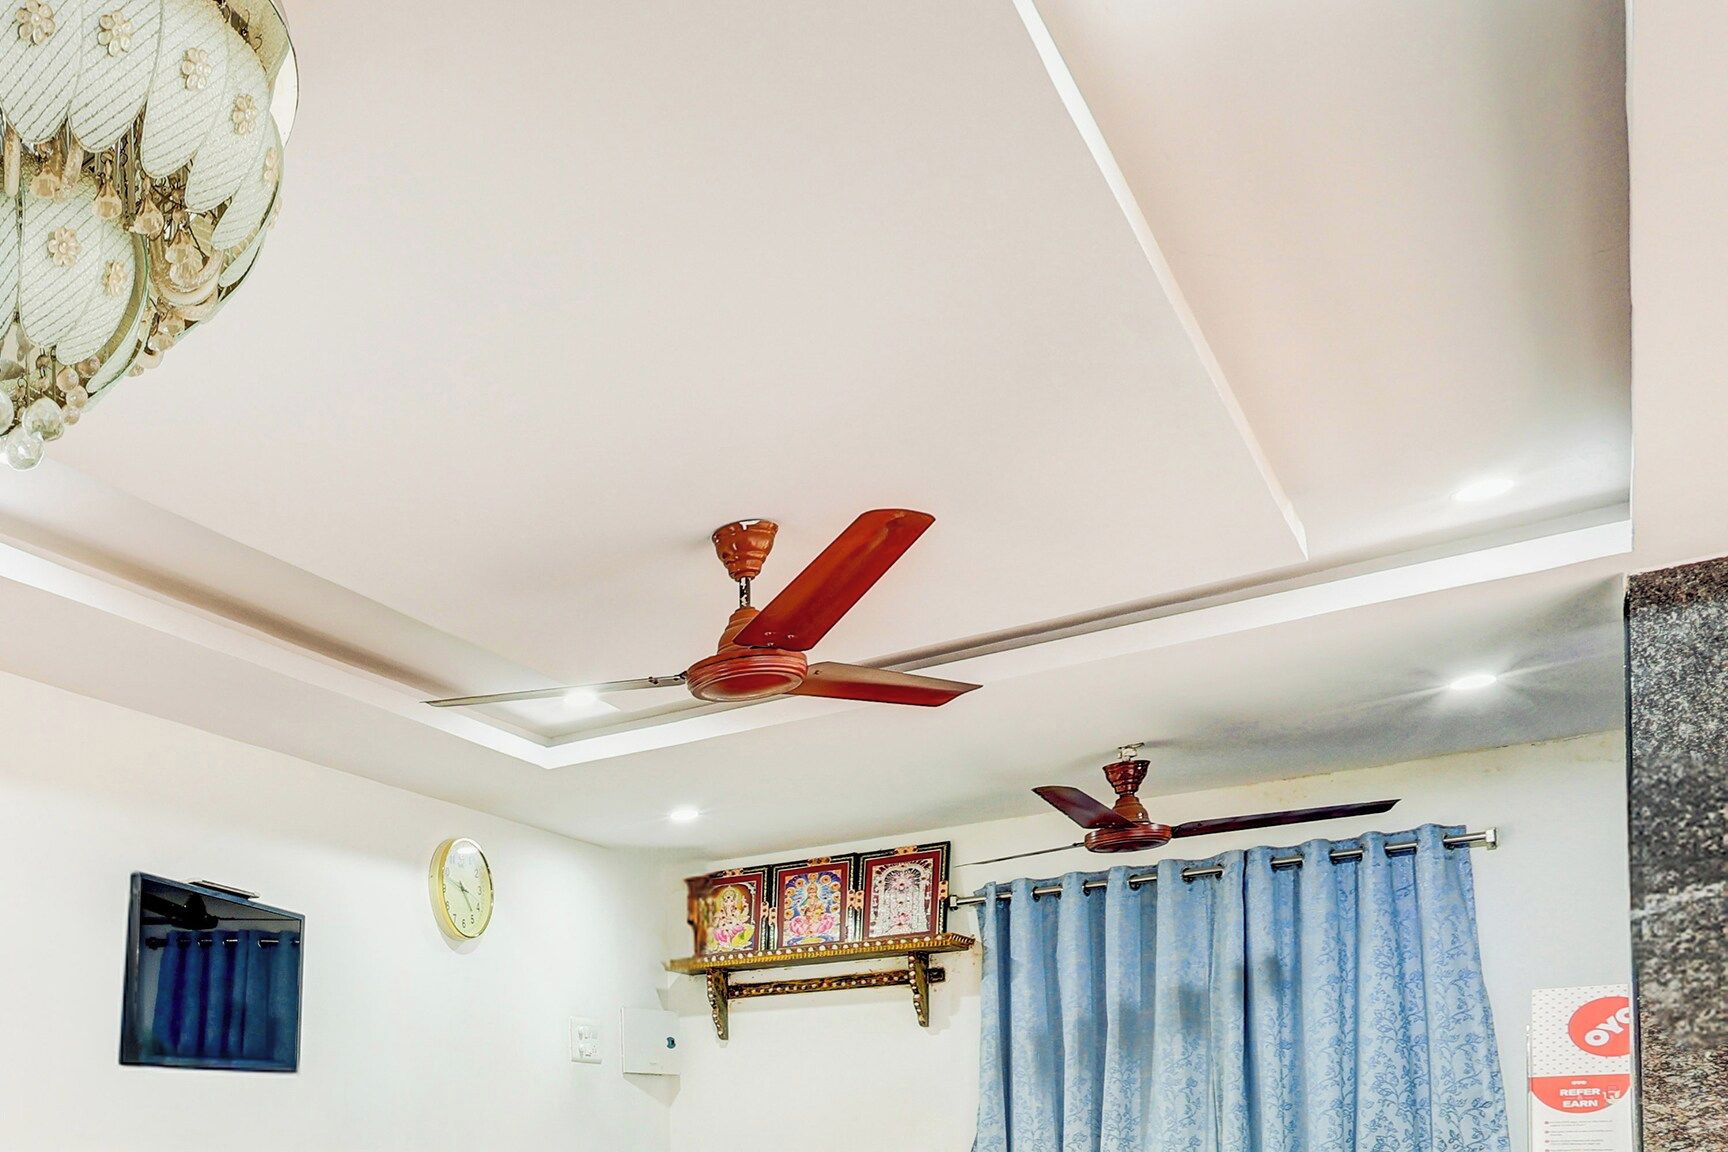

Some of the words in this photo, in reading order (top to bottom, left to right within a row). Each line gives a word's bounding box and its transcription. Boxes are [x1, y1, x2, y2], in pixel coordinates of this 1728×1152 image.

[1584, 1006, 1630, 1046] OYO
[1559, 1088, 1601, 1097] REFER
[1562, 1100, 1598, 1108] EARN
